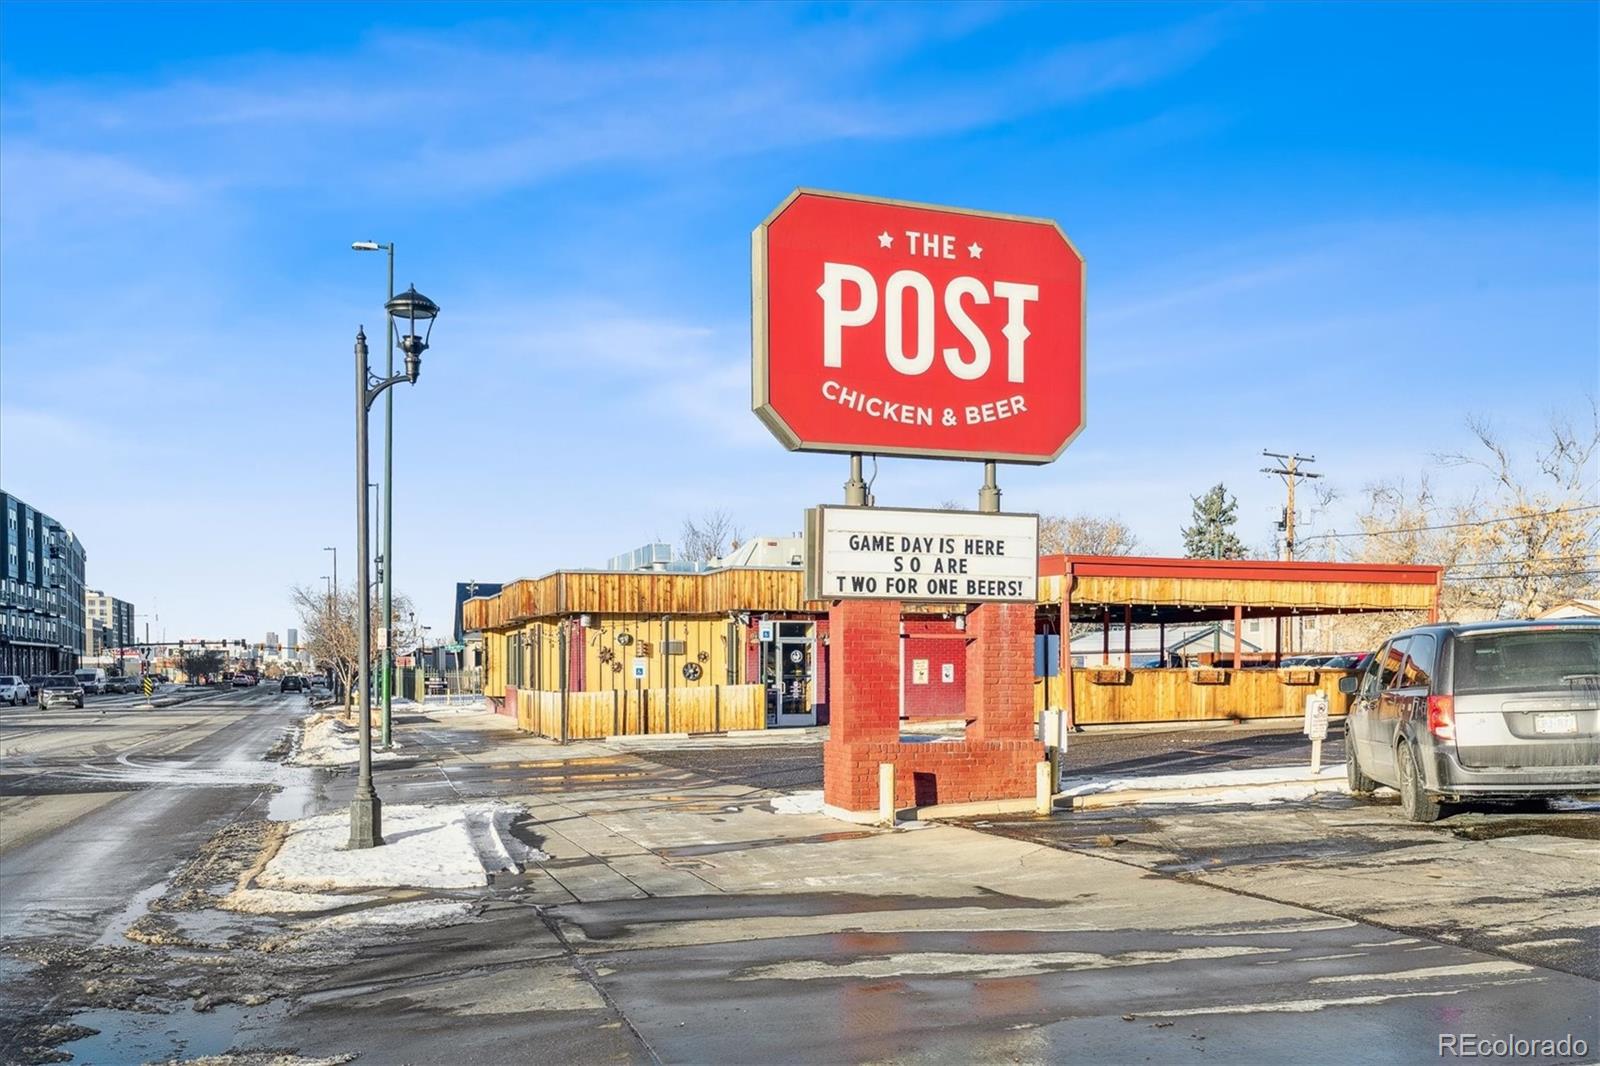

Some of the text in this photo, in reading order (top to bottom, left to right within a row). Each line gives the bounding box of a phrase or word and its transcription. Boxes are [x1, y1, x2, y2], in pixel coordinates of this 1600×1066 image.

[906, 231, 955, 259] THE
[817, 262, 1038, 385] POST
[823, 381, 1027, 426] CHICKEN & BEER
[850, 535, 1004, 555] GAME DAY IS HERE
[895, 557, 967, 573] SO ARE
[837, 577, 1022, 595] TWO FOR ONE BEERS!
